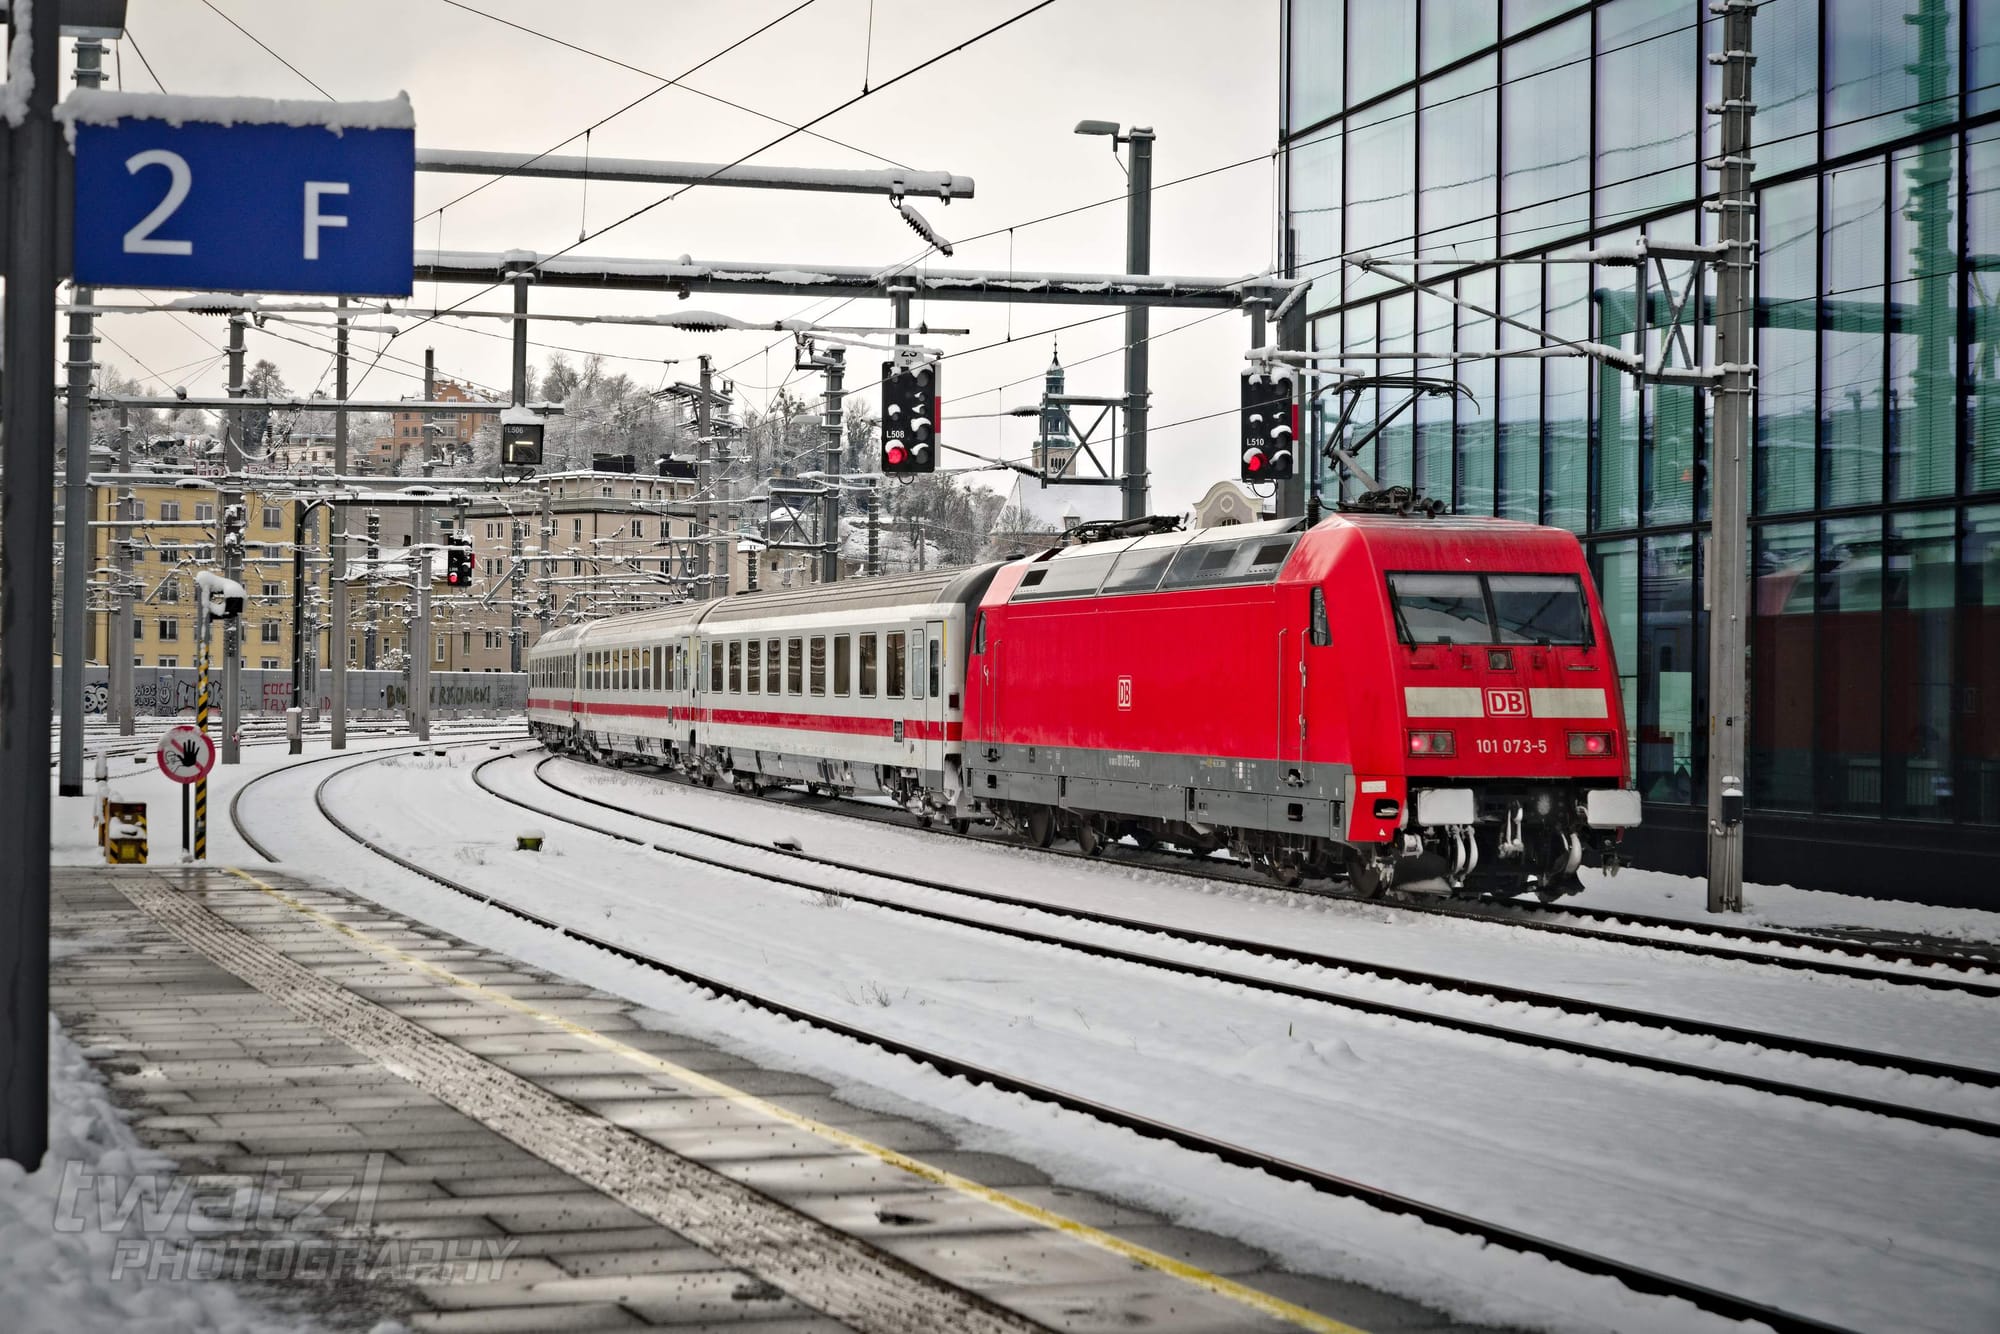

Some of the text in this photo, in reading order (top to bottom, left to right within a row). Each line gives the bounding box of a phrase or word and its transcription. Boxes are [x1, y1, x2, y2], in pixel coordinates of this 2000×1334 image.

[123, 149, 350, 260] 2 F
[886, 430, 905, 439] L508
[1246, 438, 1265, 446] L510
[1119, 681, 1130, 705] DB
[1490, 691, 1523, 713] DB
[1476, 739, 1548, 754] 101 073-5
